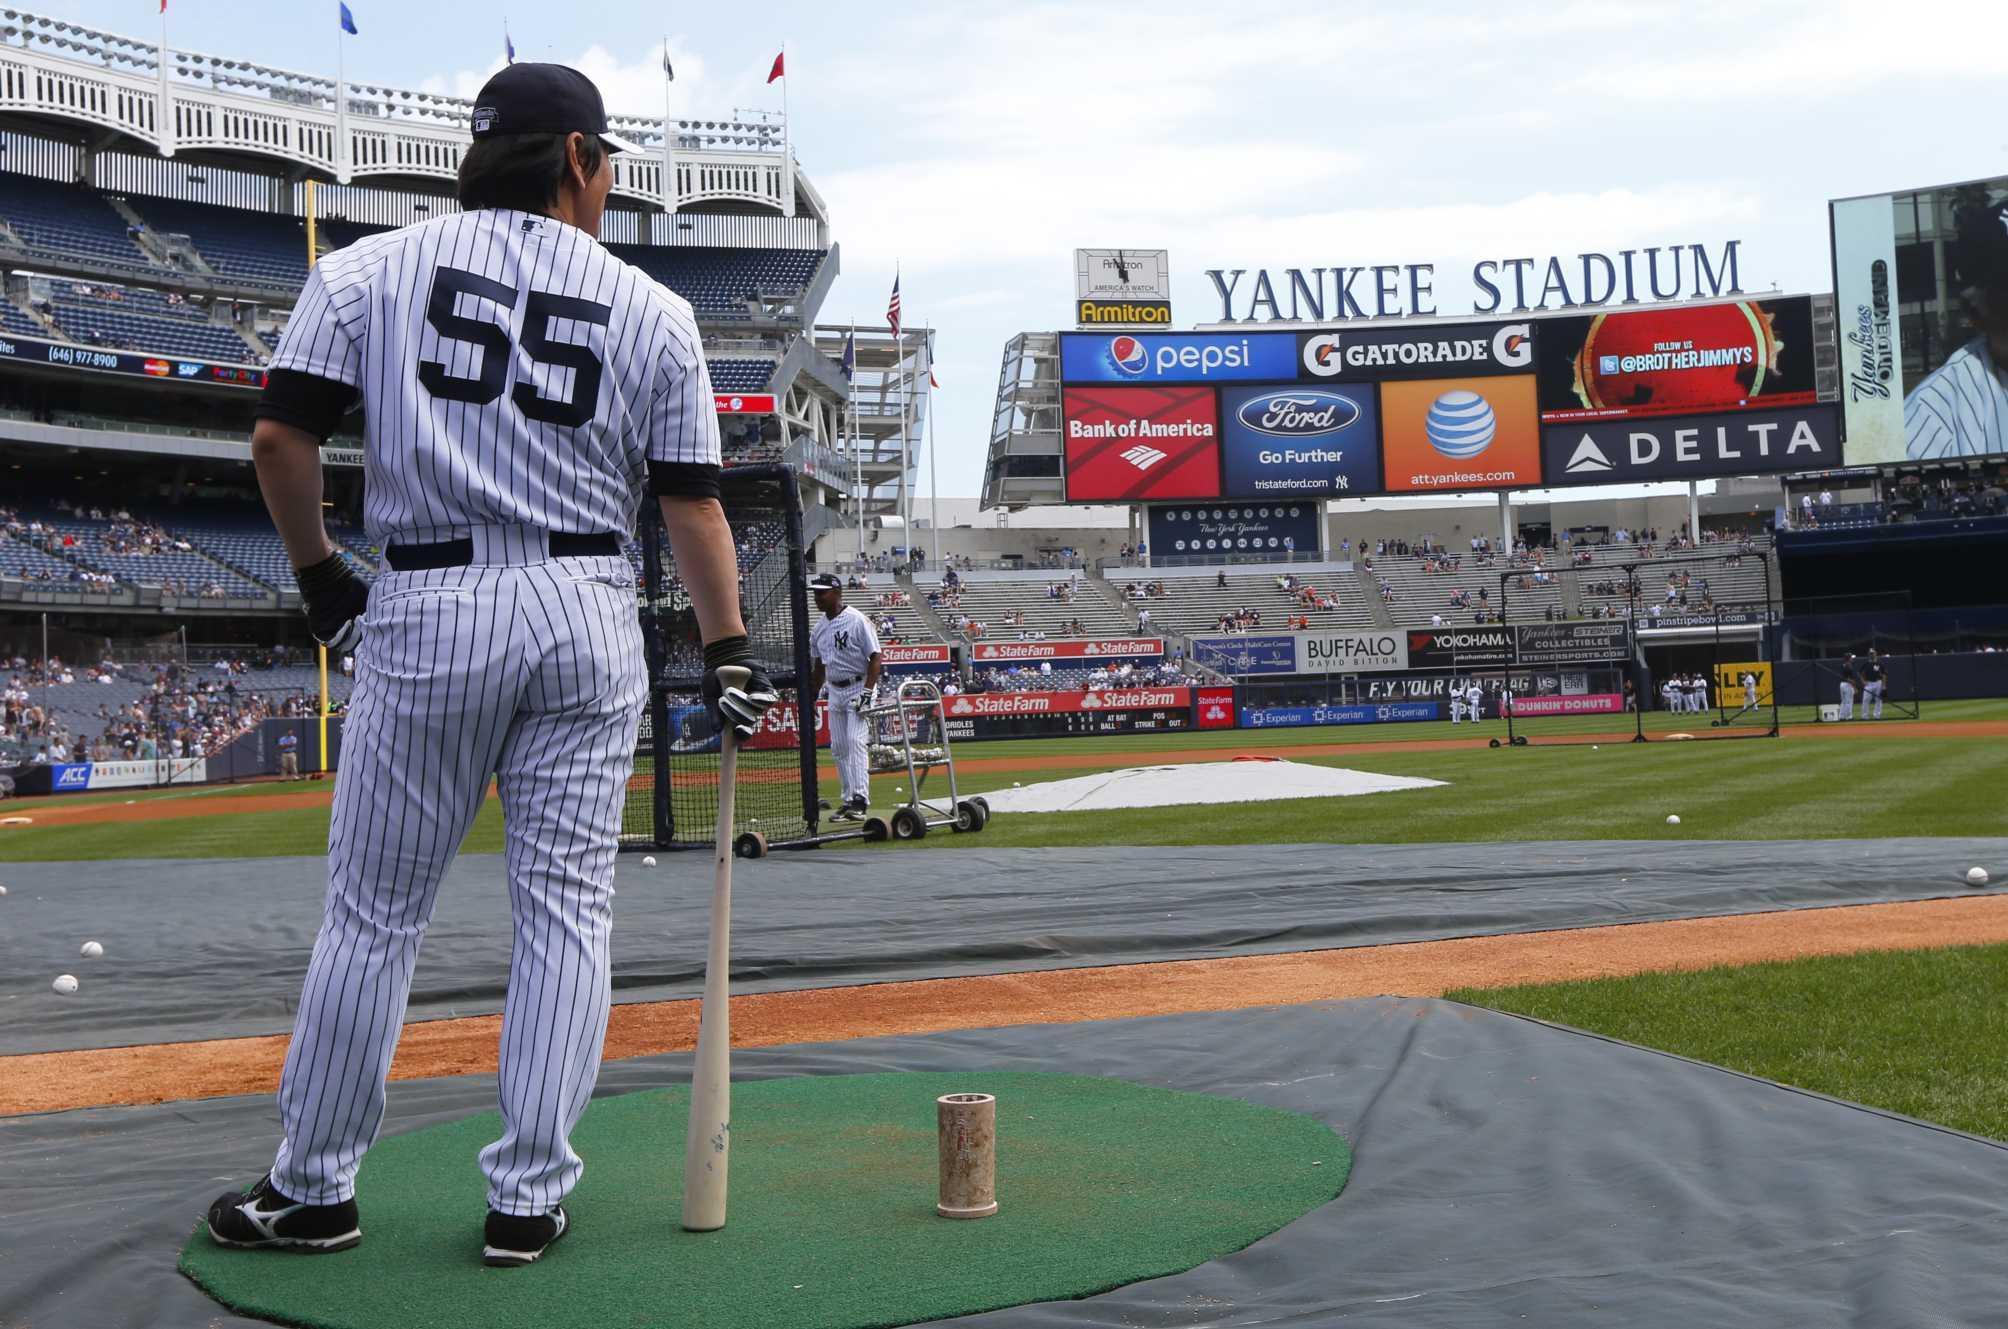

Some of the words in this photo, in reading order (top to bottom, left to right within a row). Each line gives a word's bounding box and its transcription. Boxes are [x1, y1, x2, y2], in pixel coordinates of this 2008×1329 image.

[1103, 259, 1143, 269] Armtron
[1205, 263, 1437, 322] YANKEE
[1472, 239, 1743, 313] STADIUM
[1080, 302, 1170, 322] Armitron
[418, 265, 613, 428] 55
[1346, 340, 1489, 367] GATORADE
[1654, 341, 1681, 352] FOLLOW
[1684, 340, 1693, 350] US
[49, 346, 74, 364] (646)
[76, 350, 118, 368] 977-8900
[1157, 339, 1249, 375] pepsi
[1621, 347, 1752, 373] @BROTHERJIMMYS
[178, 363, 198, 376] SAP
[1262, 399, 1336, 429] Ford
[1070, 420, 1117, 438] Bank
[1118, 420, 1137, 437] of
[1139, 419, 1213, 437] America
[1629, 421, 1822, 465] DELTA
[1259, 450, 1282, 464] Go
[1285, 448, 1342, 464] Further
[1255, 477, 1328, 489] tristateford.com
[1411, 470, 1515, 487] att.yankees.com
[1307, 637, 1396, 659] BUFFALO
[1433, 633, 1512, 648] YOKOHAMA
[1535, 638, 1610, 648] COLLECTIBLES
[1308, 659, 1345, 668] DAVID
[1353, 657, 1398, 666] BITTON
[1454, 653, 1513, 661] yokohamatire.cm
[1492, 677, 1529, 691] FAG
[1392, 705, 1428, 717] Experian
[1564, 699, 1612, 709] DONUTS
[1266, 713, 1301, 723] Experian
[1327, 711, 1363, 721] Experian
[59, 767, 87, 783] ACC
